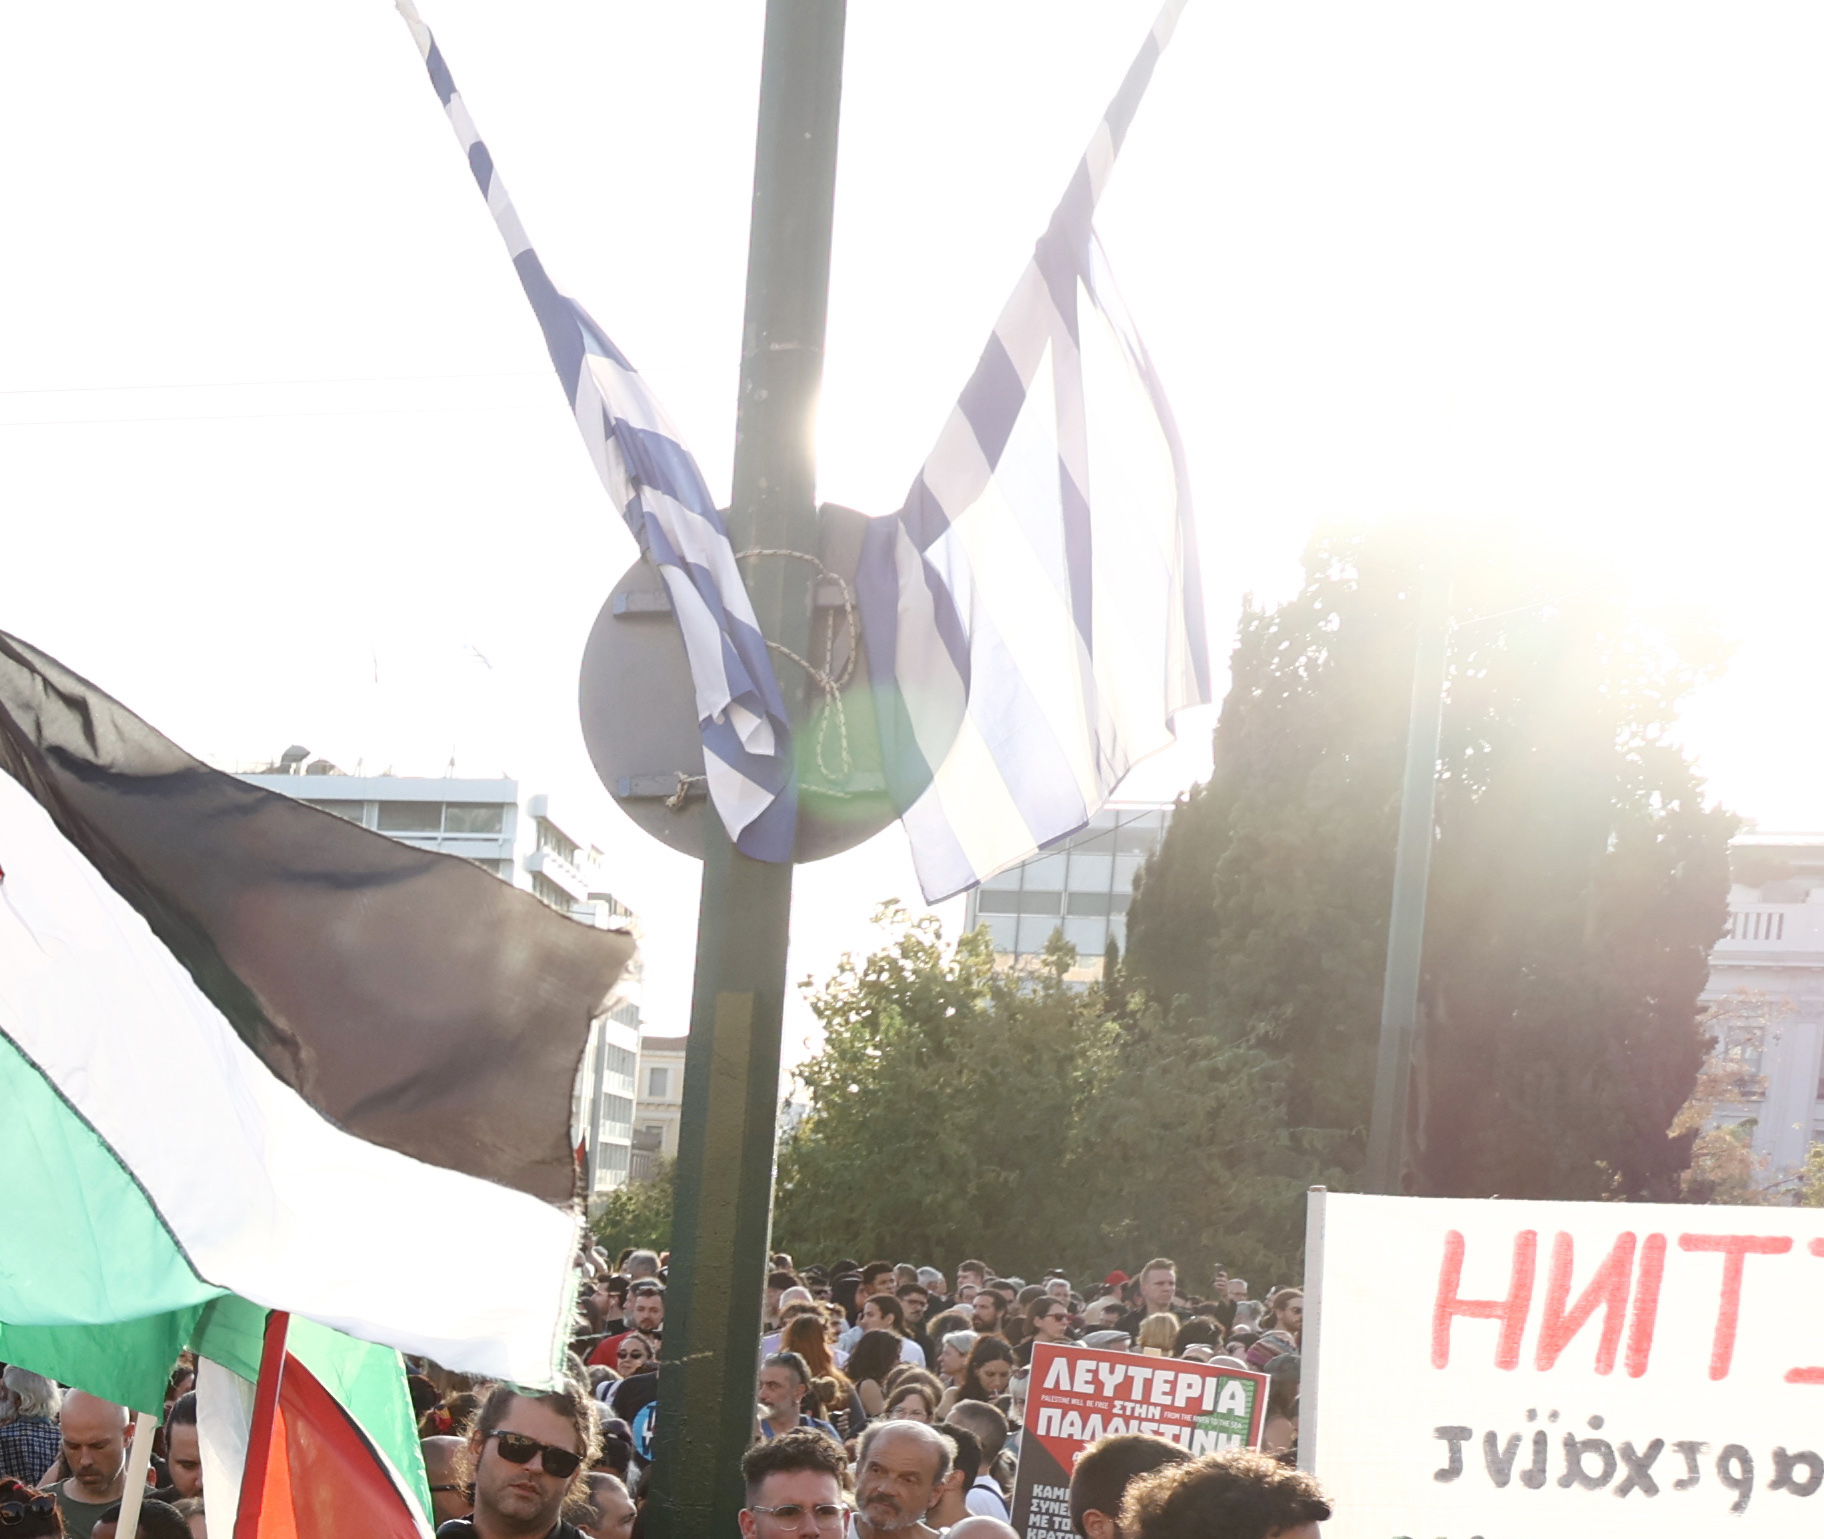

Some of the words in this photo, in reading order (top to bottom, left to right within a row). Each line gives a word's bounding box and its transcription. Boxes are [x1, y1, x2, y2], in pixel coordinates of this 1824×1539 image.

[1042, 1357, 1247, 1416] ΛΕΥΤΕΡΙΑ
[1111, 1400, 1162, 1420] ΣΤΗΝ
[1028, 1513, 1049, 1528] ΜΕ
